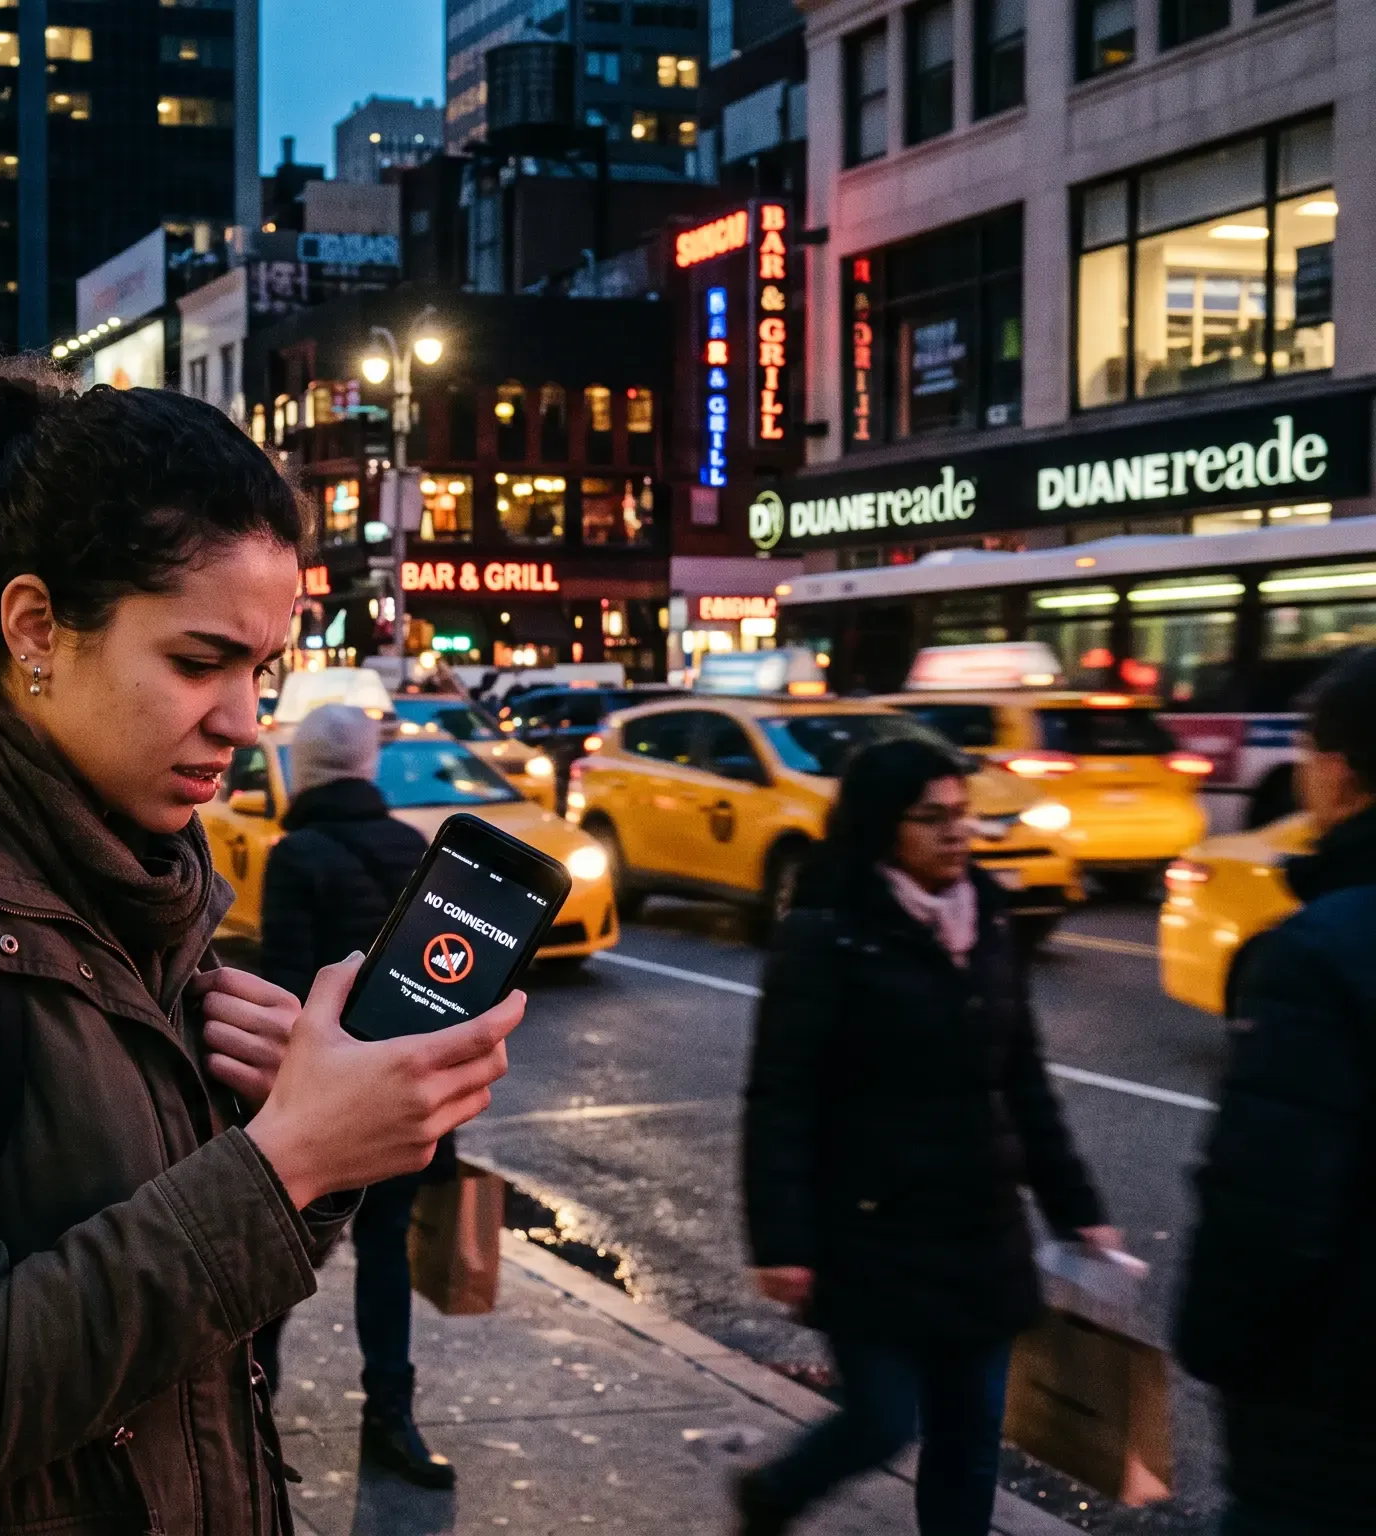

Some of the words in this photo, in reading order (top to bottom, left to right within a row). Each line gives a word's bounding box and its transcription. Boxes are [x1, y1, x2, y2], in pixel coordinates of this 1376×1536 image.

[759, 205, 786, 279] BAR
[760, 285, 786, 311] &
[759, 317, 786, 439] GRILL
[400, 561, 455, 591] BAR
[459, 562, 480, 592] &
[483, 562, 560, 592] GRILL
[424, 891, 444, 909] NO
